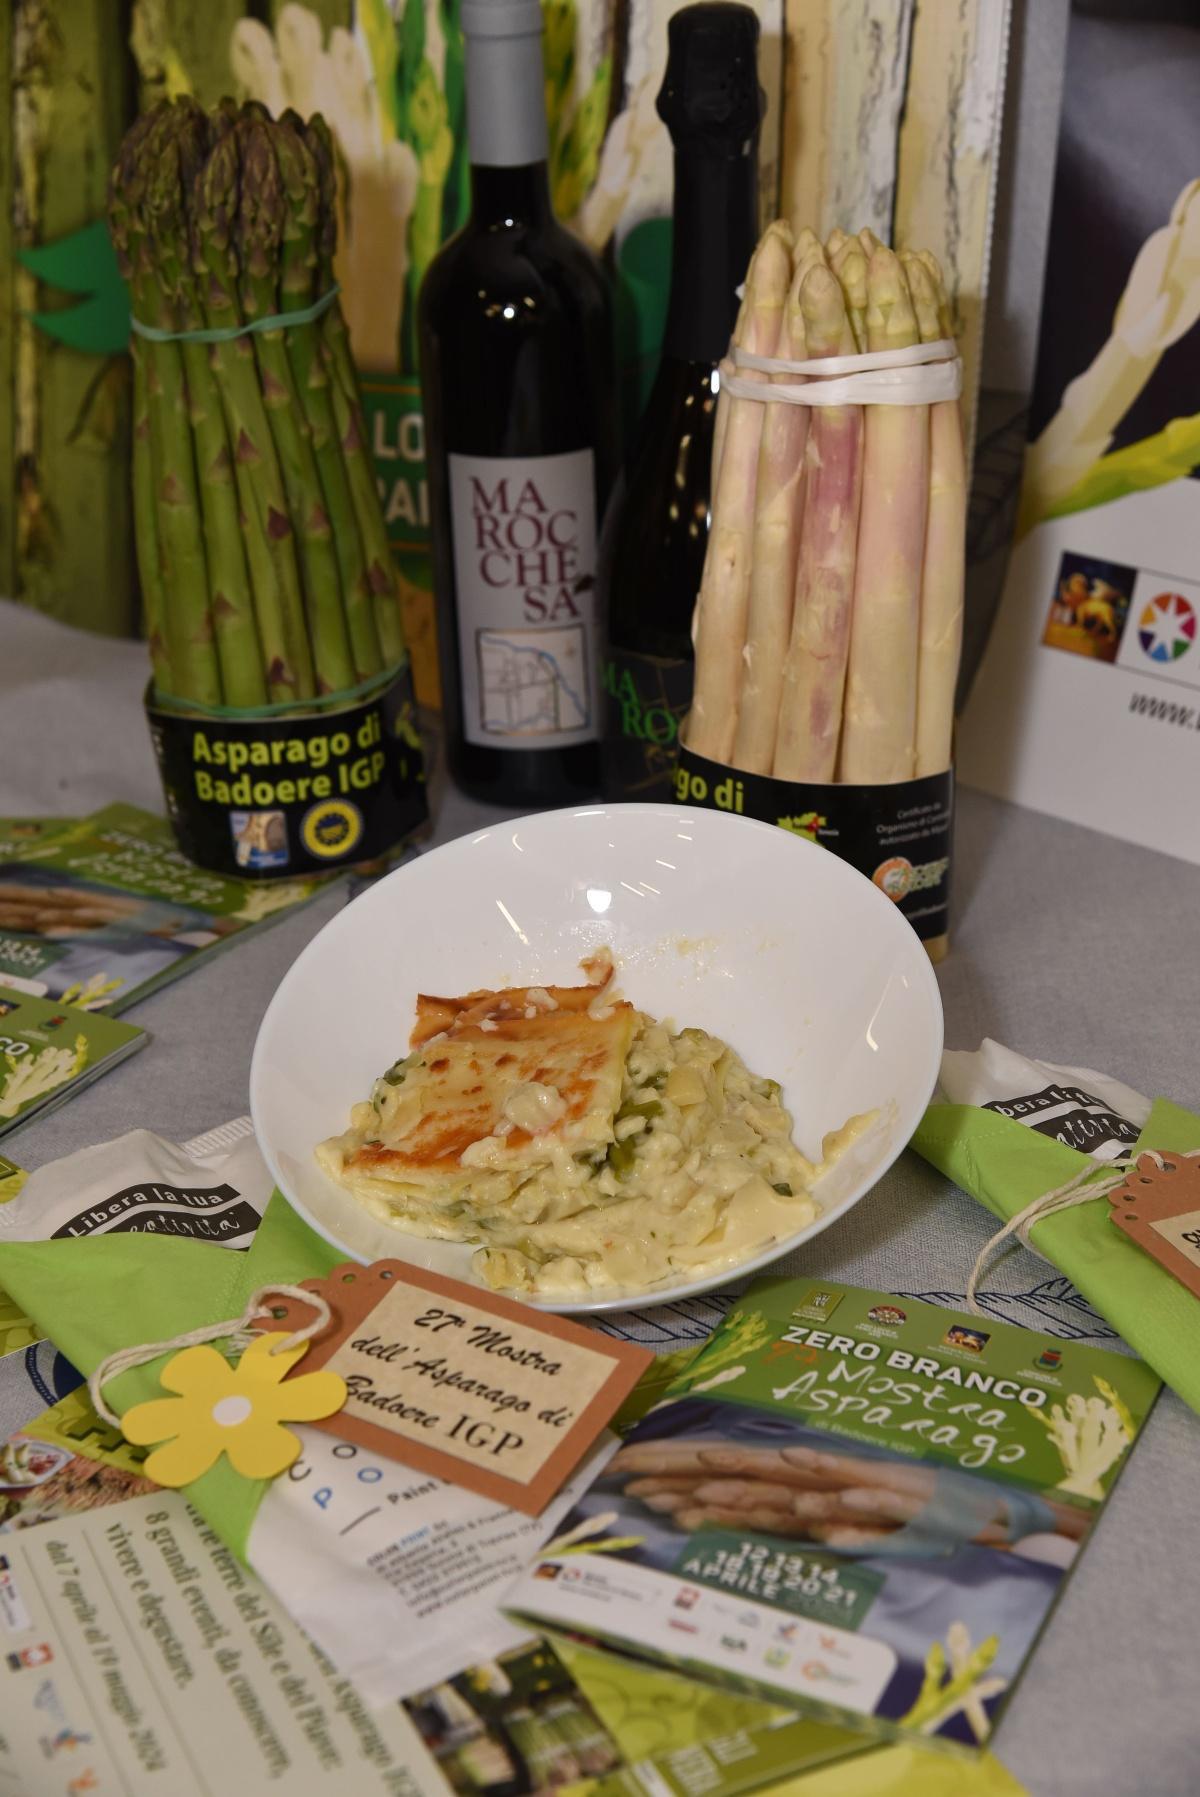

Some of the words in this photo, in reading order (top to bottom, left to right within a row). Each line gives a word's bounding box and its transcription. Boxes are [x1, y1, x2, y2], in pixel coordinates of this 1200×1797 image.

[469, 476, 548, 515] MA
[474, 511, 578, 551] ROC
[479, 549, 581, 588] CHE
[522, 586, 581, 624] SA
[192, 731, 351, 774] Asparago
[356, 711, 382, 748] di
[193, 768, 332, 806] Badoere
[338, 752, 385, 794] IGP
[674, 767, 708, 801] go
[714, 777, 744, 814] di
[67, 1189, 148, 1238] Libera
[152, 1187, 178, 1202] la
[182, 1192, 223, 1207] tua
[466, 1325, 563, 1376] Mostra
[781, 1325, 881, 1361] ZERO
[886, 1350, 1048, 1408] BRANCO
[345, 1374, 441, 1429] Badoere
[446, 1412, 524, 1456] IGP
[537, 1405, 574, 1428] di
[145, 1510, 170, 1525] 8
[105, 1521, 144, 1580] vivere
[144, 1524, 201, 1585] grandi
[682, 1557, 780, 1600] APRILE
